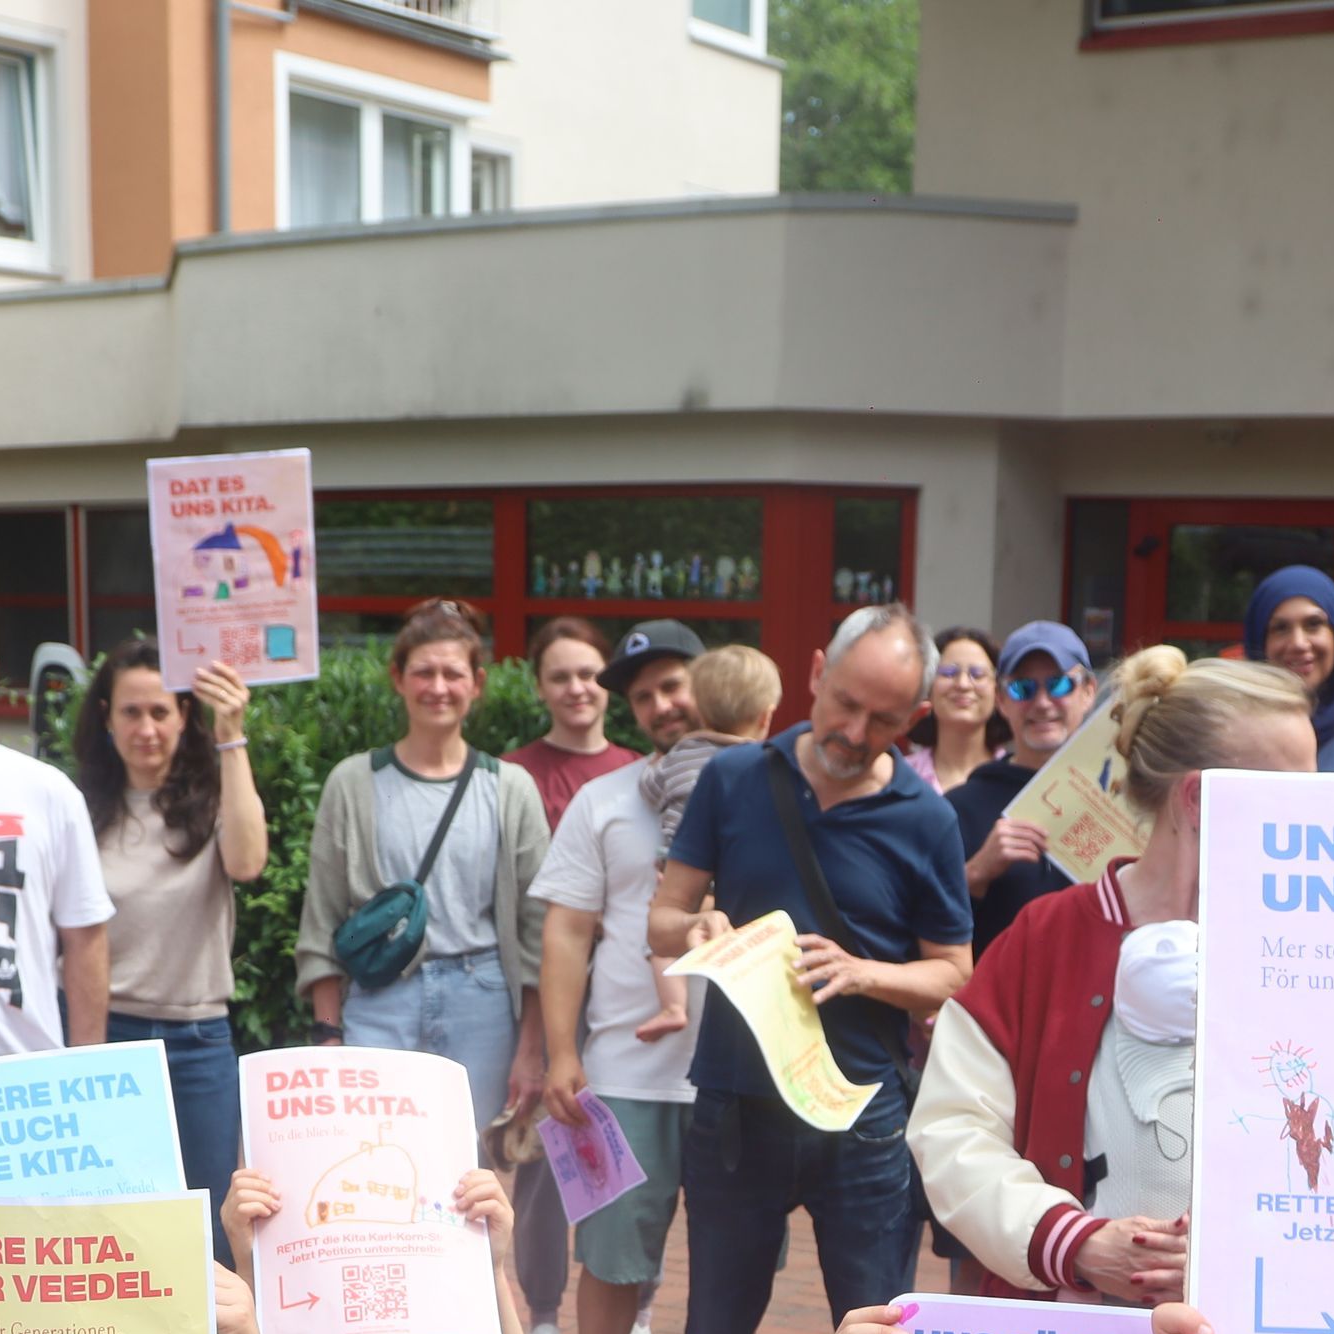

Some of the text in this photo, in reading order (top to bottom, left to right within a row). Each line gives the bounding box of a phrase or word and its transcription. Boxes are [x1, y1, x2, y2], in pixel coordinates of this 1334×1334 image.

[170, 475, 244, 496] DAT ES
[170, 496, 276, 517] UNS KITA.
[1260, 935, 1306, 961] Mer
[1260, 966, 1300, 989] För
[60, 1072, 141, 1105] KITA
[267, 1069, 379, 1092] DAT ES
[267, 1095, 428, 1120] UNS KITA.
[21, 1144, 113, 1178] KITA.
[35, 1235, 135, 1265] KITA.
[12, 1271, 173, 1303] VEEDEL.
